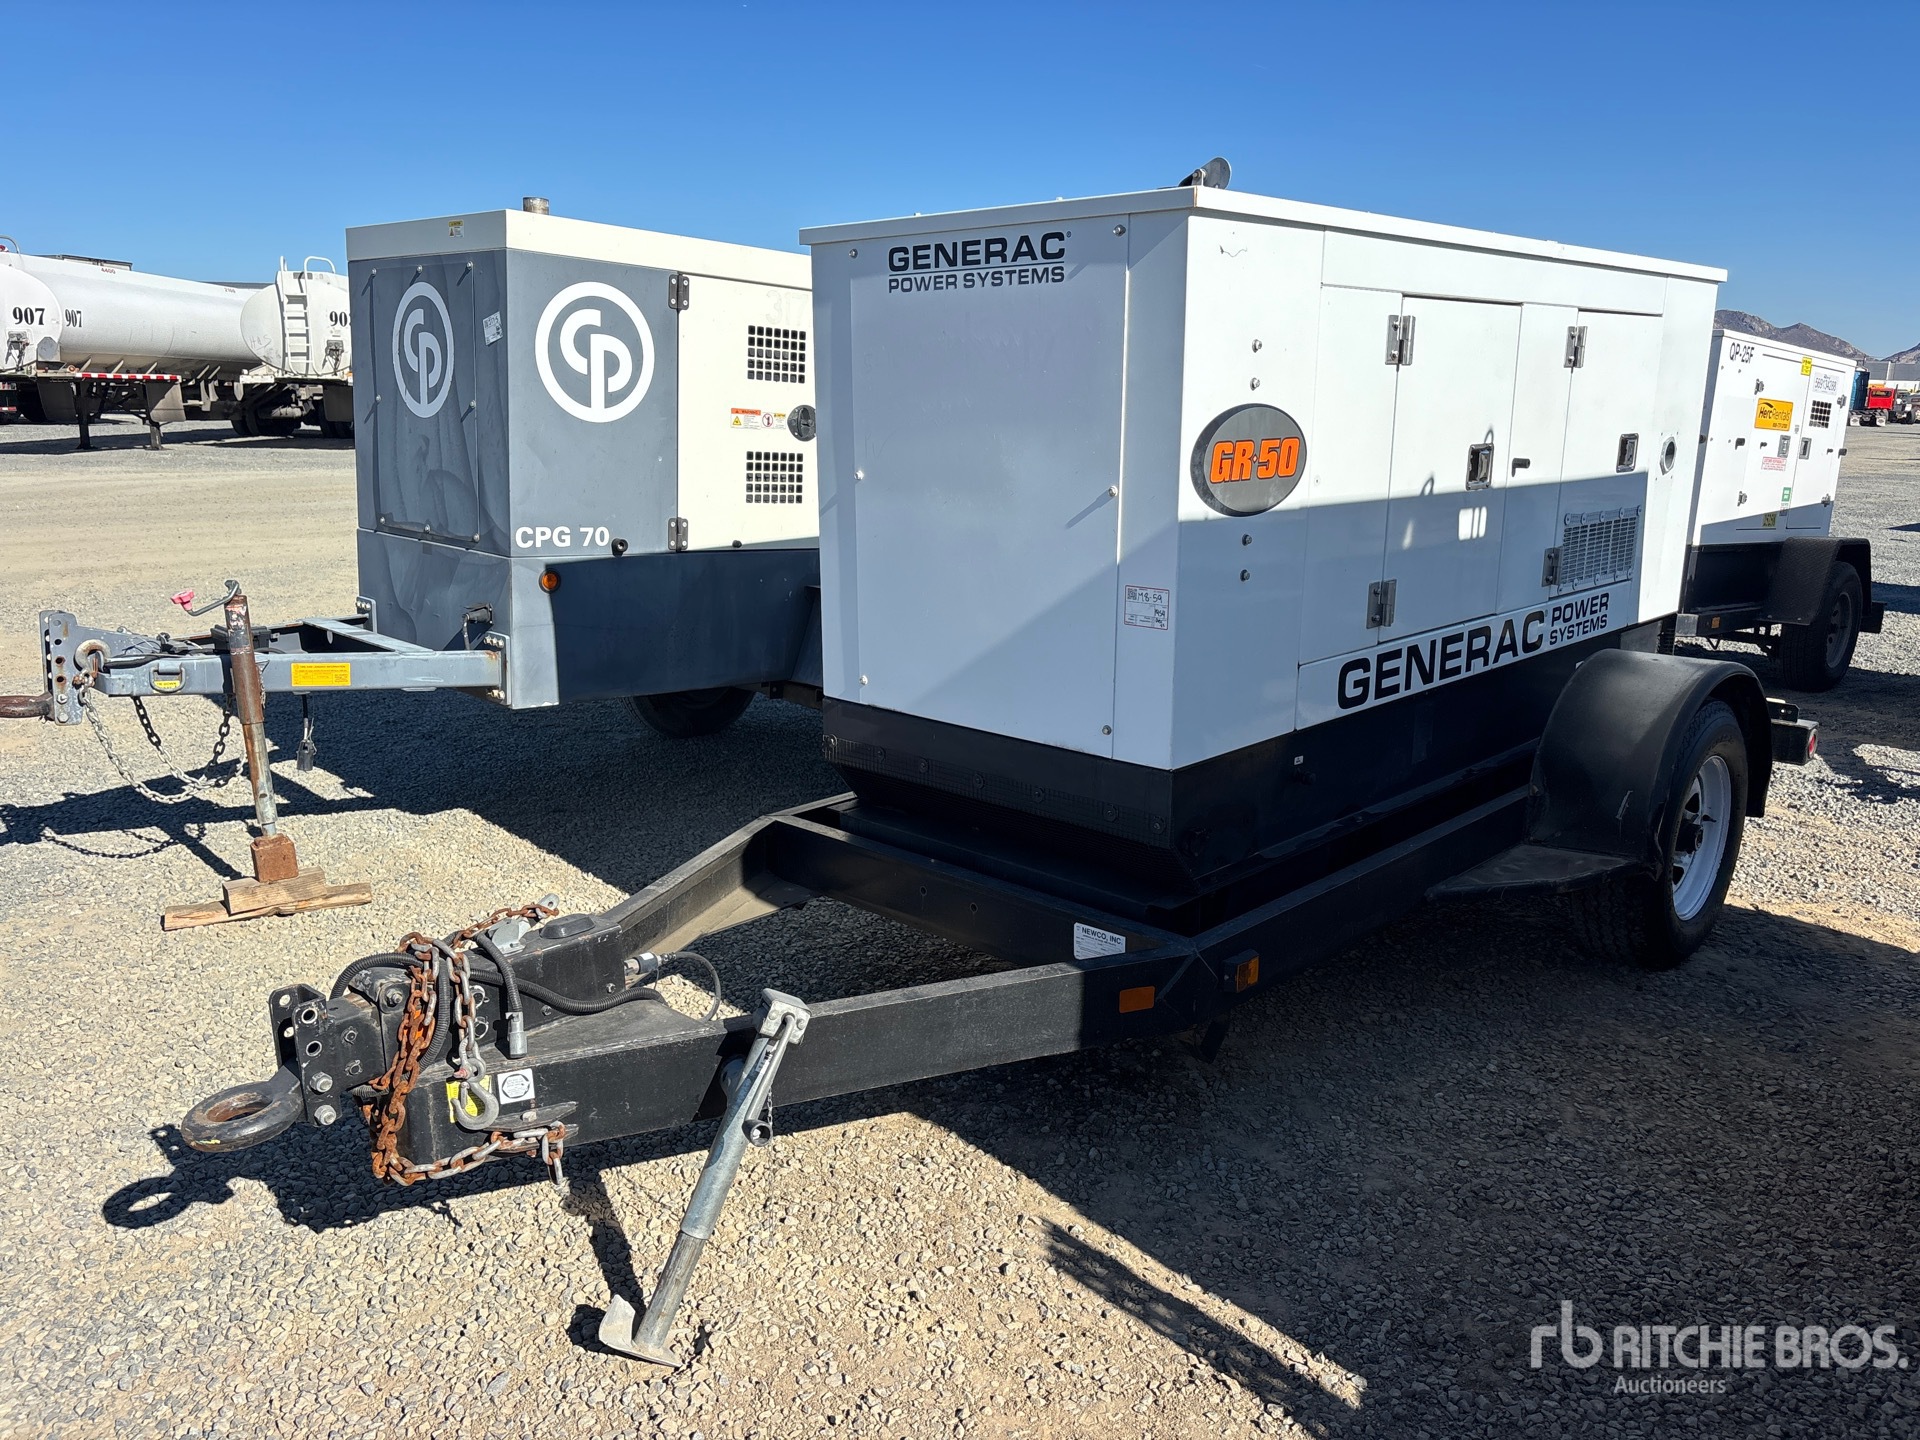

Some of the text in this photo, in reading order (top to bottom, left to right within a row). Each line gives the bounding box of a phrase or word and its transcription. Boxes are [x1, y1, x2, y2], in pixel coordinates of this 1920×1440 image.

[888, 231, 1065, 273] GENERAC
[888, 265, 1065, 294] POWER SYSTEMS
[12, 306, 45, 326] 907
[64, 308, 83, 328] 907
[329, 310, 352, 328] 90
[514, 526, 611, 549] CPG 70
[1549, 613, 1609, 646] SYSTEMS
[1336, 592, 1610, 710] GENERAC POWER
